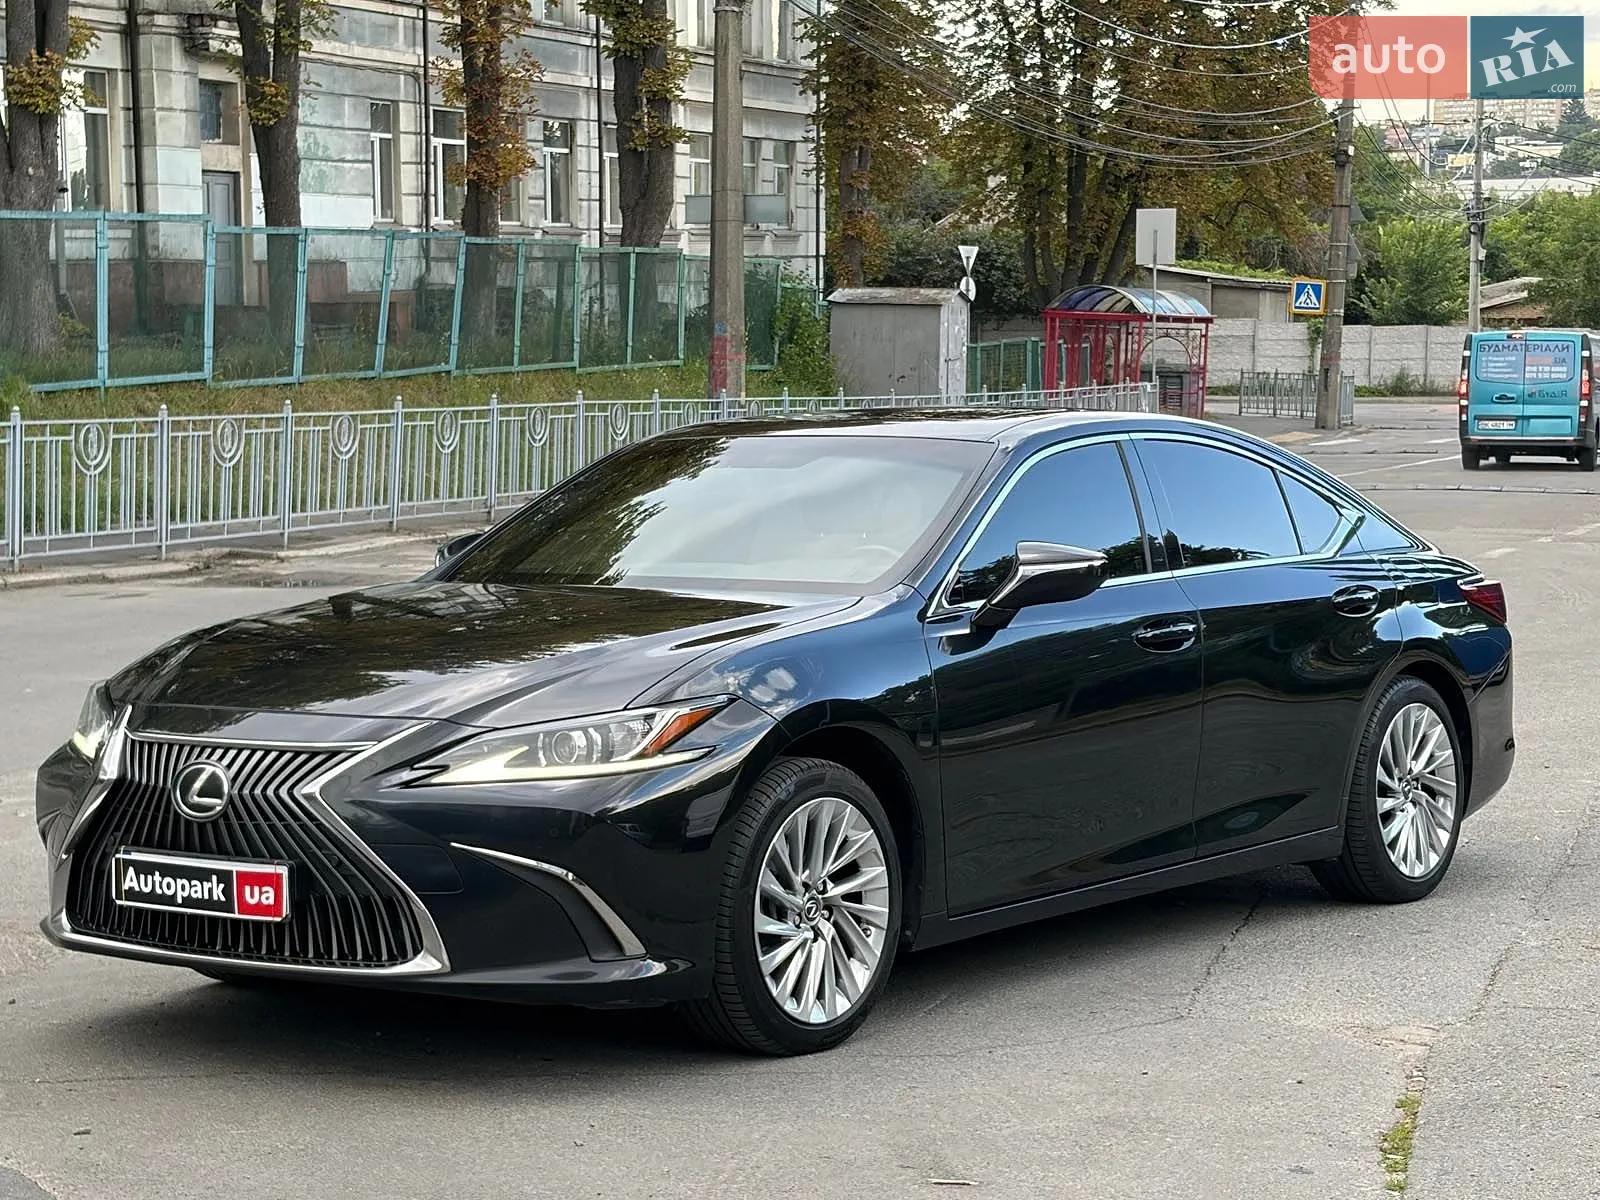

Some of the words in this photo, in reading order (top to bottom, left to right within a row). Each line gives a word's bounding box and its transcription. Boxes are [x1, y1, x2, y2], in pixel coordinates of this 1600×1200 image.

[1479, 343, 1570, 353] БУДМАТЕРІАЛИ
[124, 866, 226, 904] Autopark
[244, 884, 275, 905] ua
